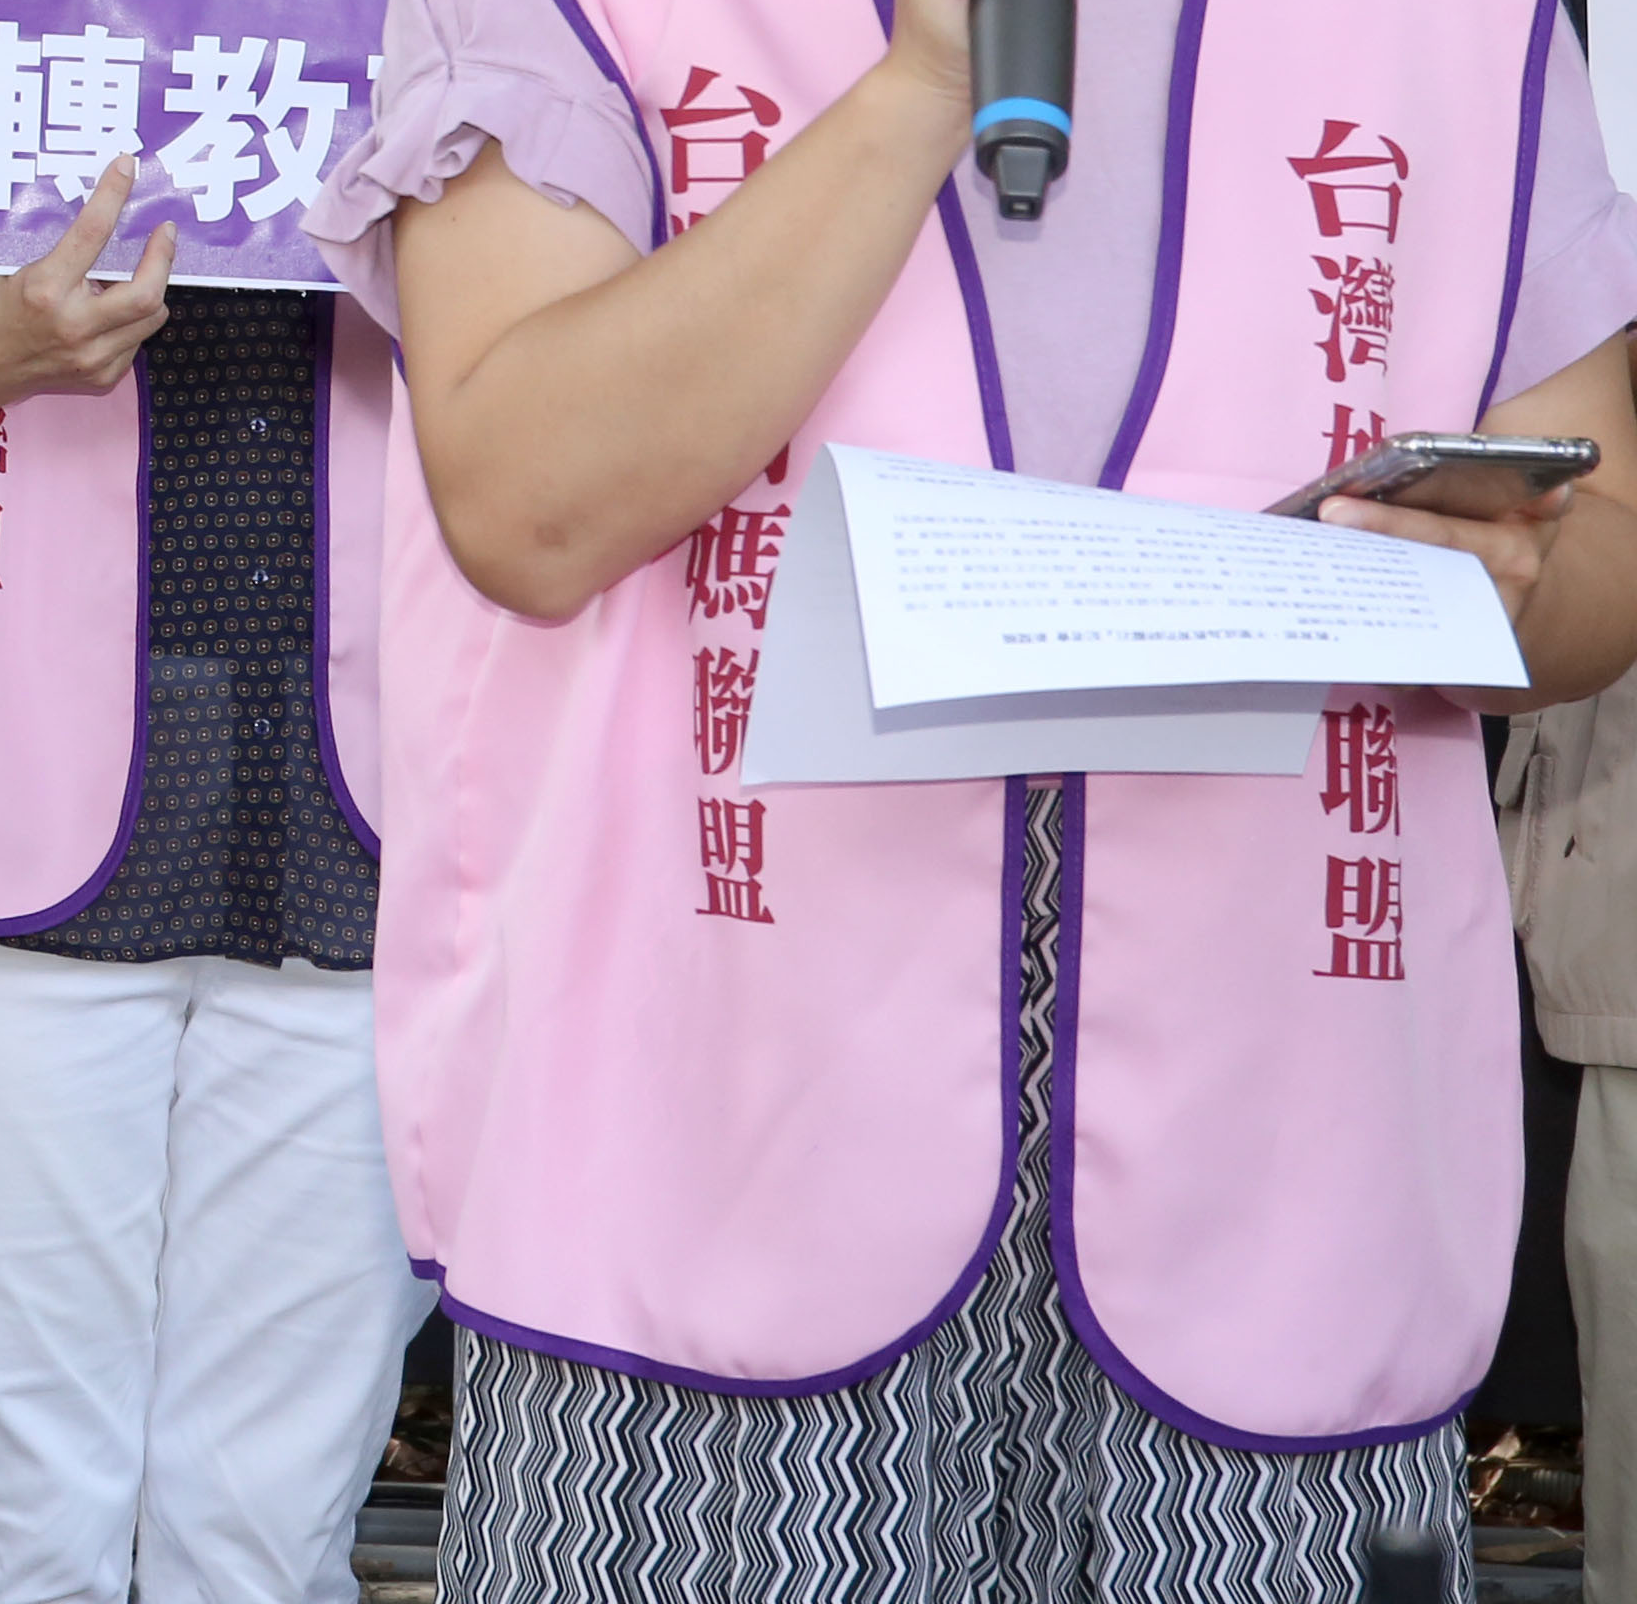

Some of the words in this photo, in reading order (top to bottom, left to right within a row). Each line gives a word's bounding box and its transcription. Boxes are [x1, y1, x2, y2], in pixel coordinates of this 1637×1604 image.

[659, 66, 792, 925] 台媽聯盟
[1285, 119, 1410, 981] 台灣聯盟
